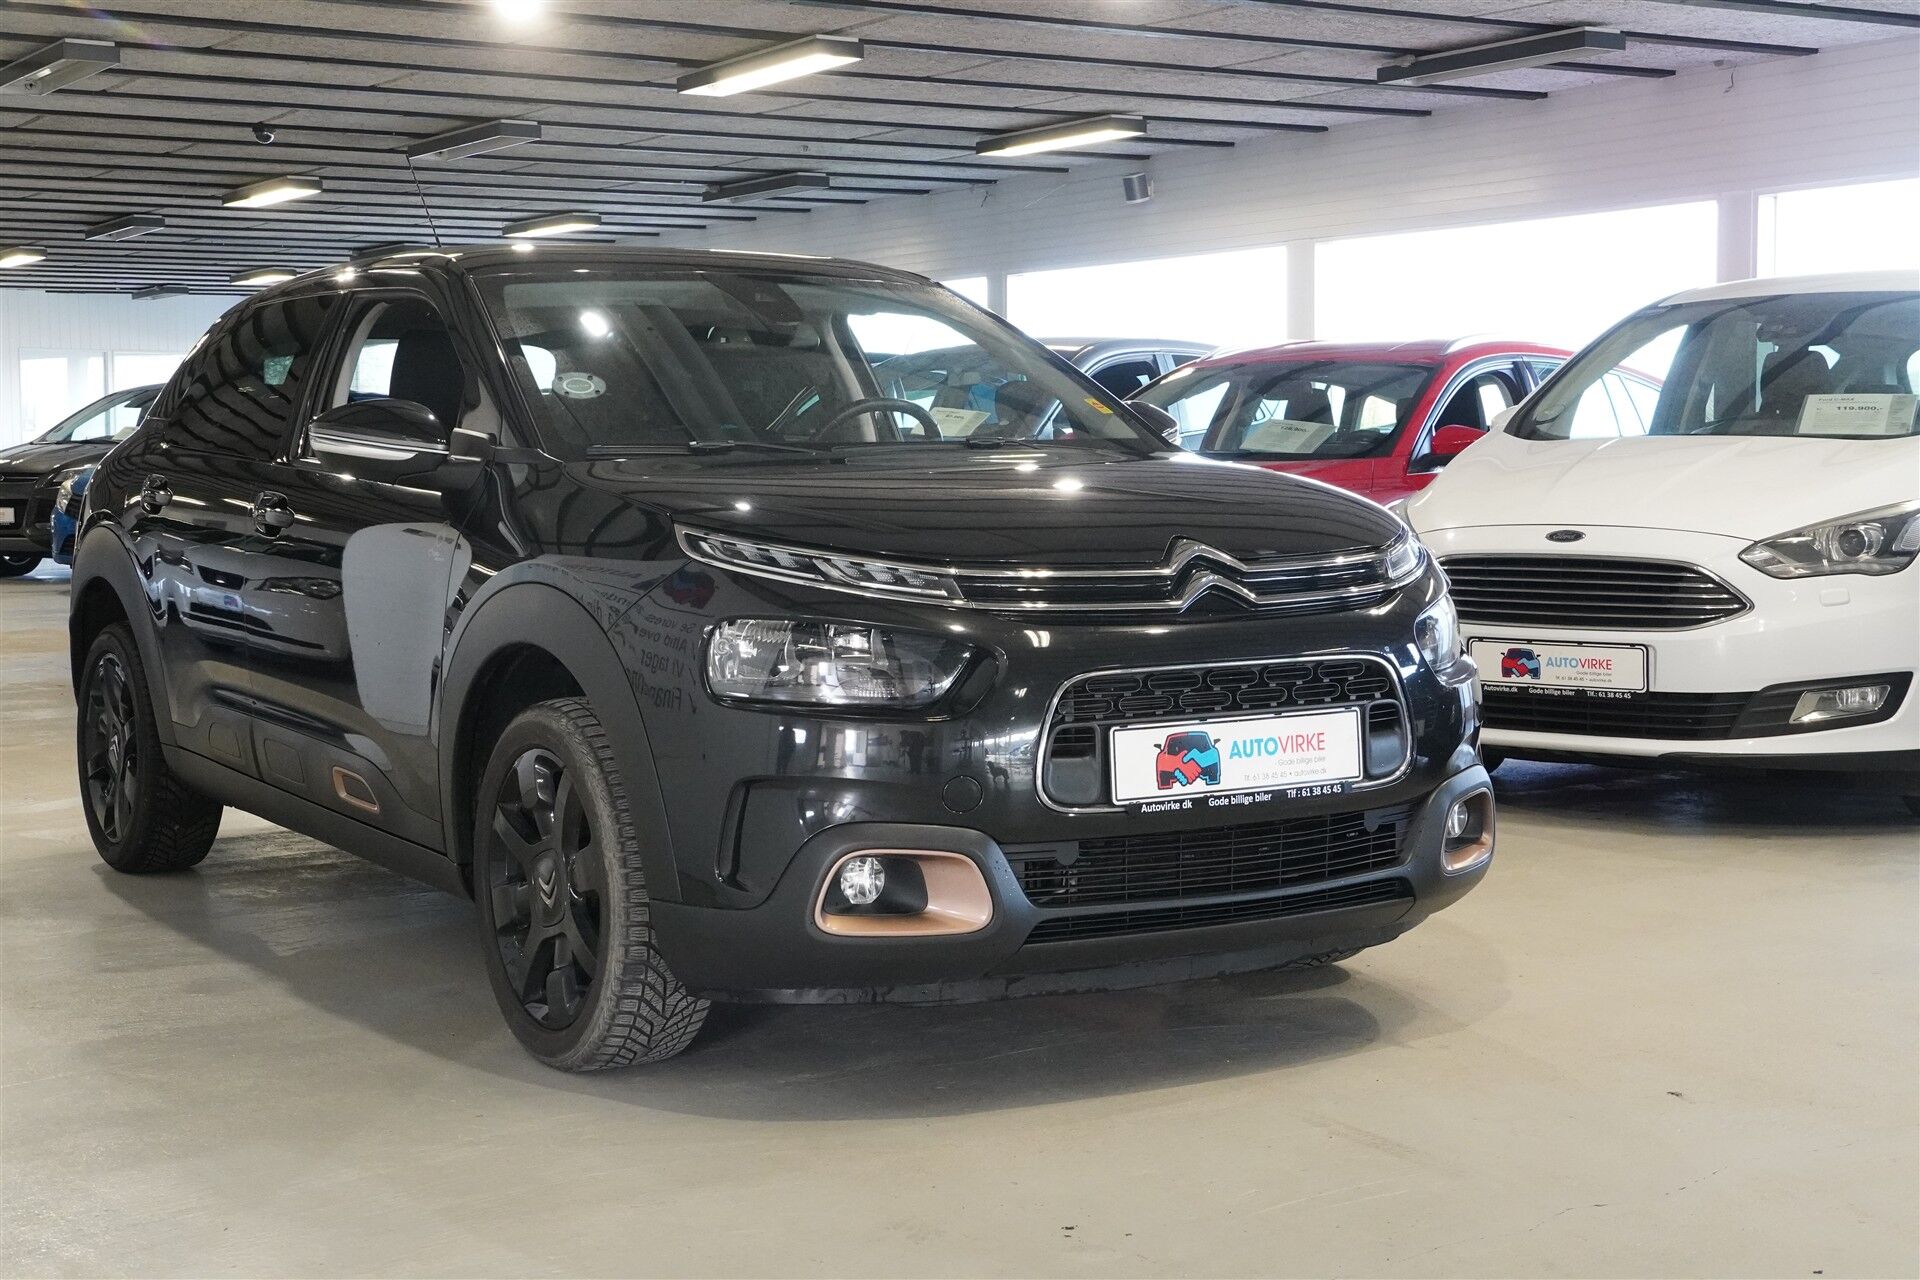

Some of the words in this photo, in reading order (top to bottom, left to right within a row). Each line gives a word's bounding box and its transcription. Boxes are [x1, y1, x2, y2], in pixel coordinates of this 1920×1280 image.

[1546, 656, 1612, 670] AUTOVIRKE
[1483, 685, 1518, 693] Autovirke.dk
[1544, 688, 1561, 696] billige
[1561, 688, 1575, 697] biler
[1229, 732, 1326, 760] AUTOVIRKE
[1278, 758, 1295, 766] Gode
[1296, 757, 1313, 767] billige
[1252, 773, 1260, 781] 61
[1280, 770, 1288, 778] 45
[1208, 797, 1229, 806] Gode
[1230, 795, 1254, 805] billige
[1254, 792, 1272, 802] biler
[1301, 788, 1311, 797] 61
[1312, 786, 1321, 796] 38
[1322, 785, 1332, 795] 45
[1332, 784, 1342, 794] 45
